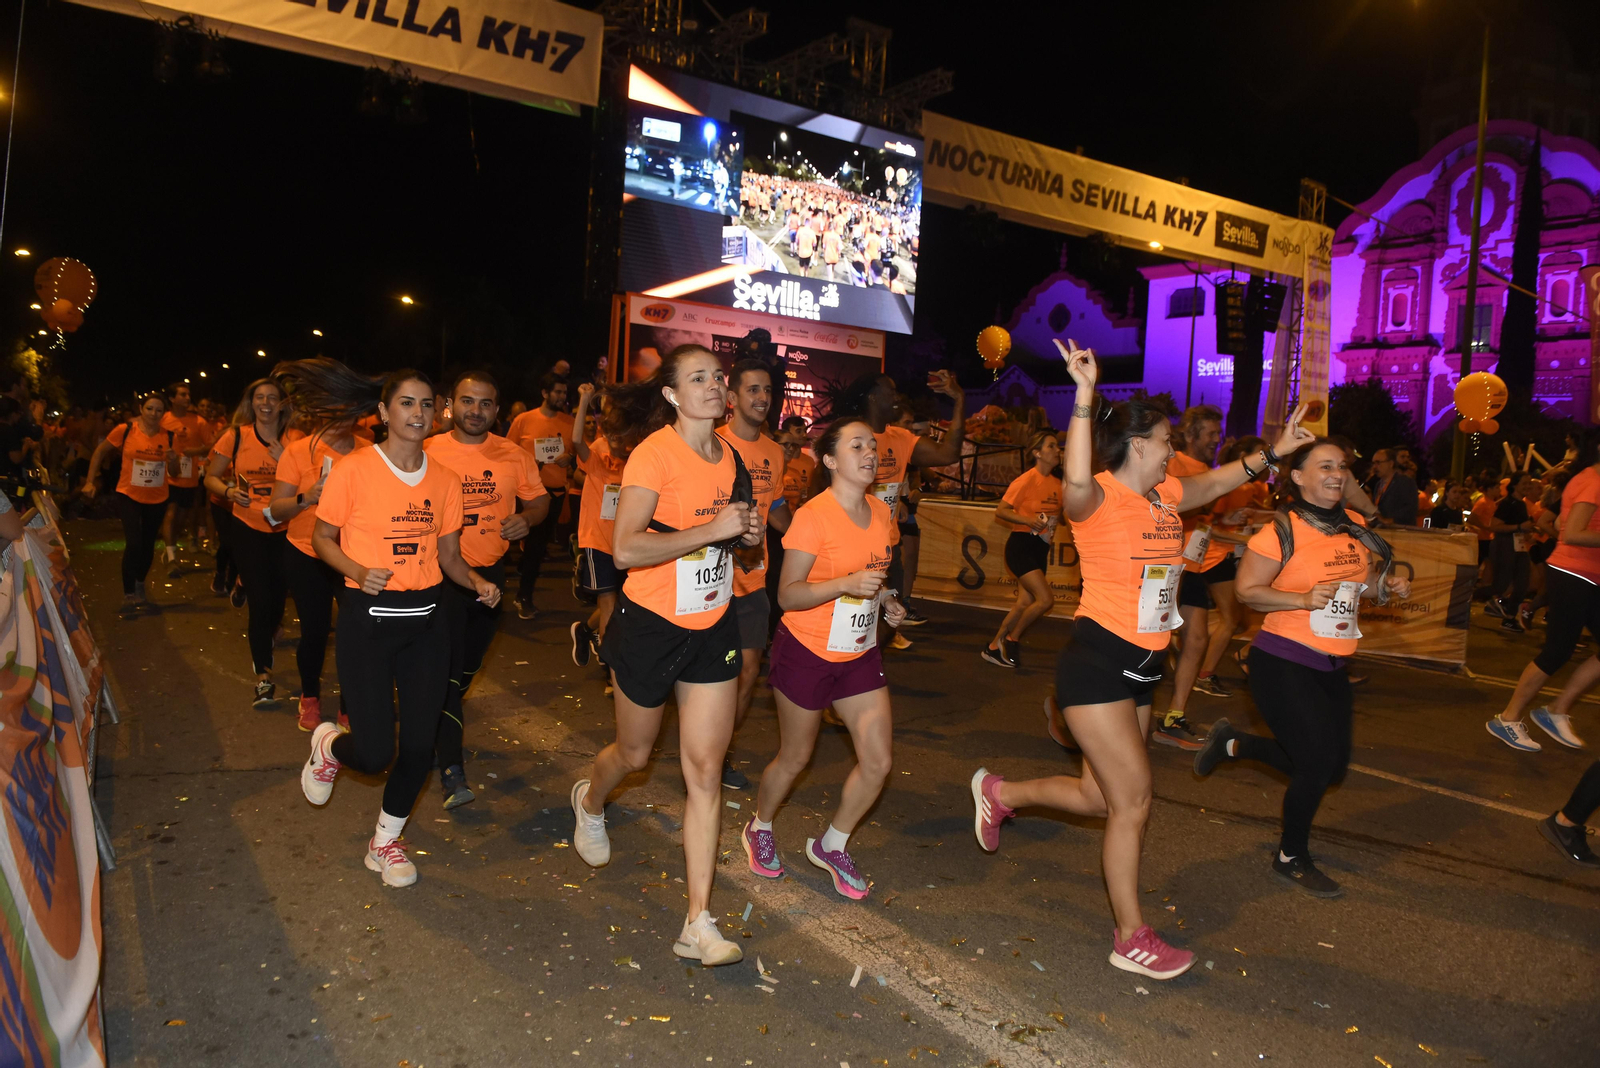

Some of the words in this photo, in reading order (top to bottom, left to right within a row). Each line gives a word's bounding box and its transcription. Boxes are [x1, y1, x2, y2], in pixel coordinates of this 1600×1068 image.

[927, 138, 1064, 199] NOCTURNA
[1070, 178, 1157, 223] SEVILLA
[705, 317, 736, 327] Cruzcampo
[541, 445, 560, 453] 16495
[1142, 532, 1171, 540] SEVILLA
[1323, 559, 1348, 567] SEVILLA
